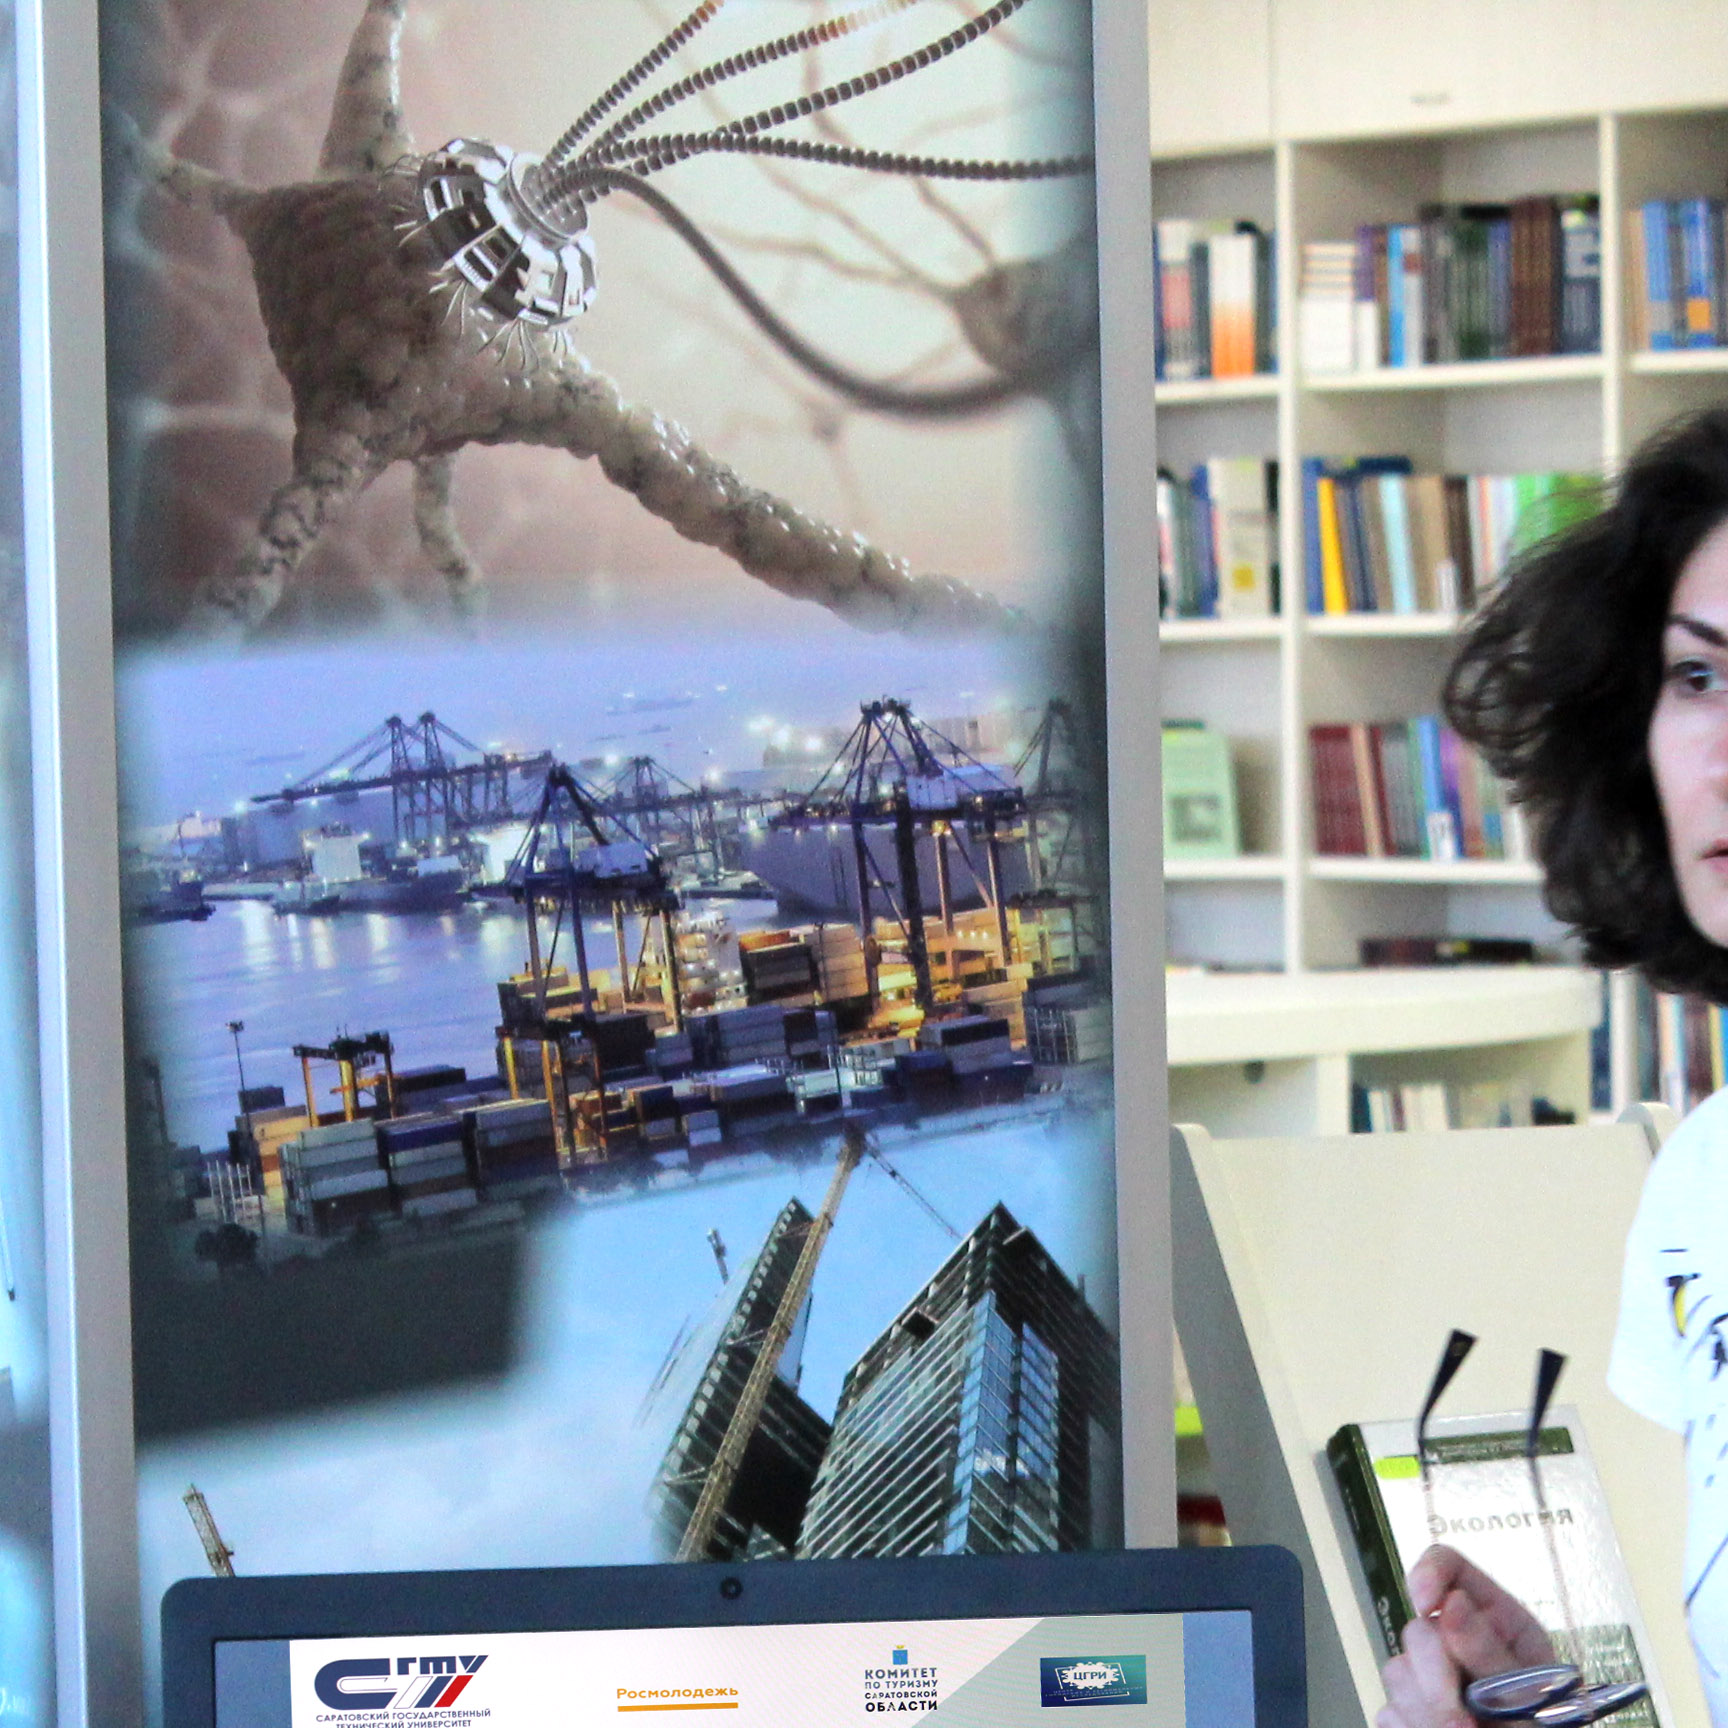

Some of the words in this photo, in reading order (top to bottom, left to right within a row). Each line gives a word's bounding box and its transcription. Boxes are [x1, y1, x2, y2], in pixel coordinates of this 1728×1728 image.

[864, 1667, 938, 1680] КОМИТЕТ
[1073, 1671, 1107, 1680] ЦГРИ
[864, 1681, 881, 1690] ПО
[885, 1679, 939, 1689] ТУРИЗМУ
[616, 1687, 739, 1699] Росмолодежь
[864, 1689, 938, 1700] САРАТОВСКОЙ
[865, 1700, 938, 1713] ОБЛАСТИ
[315, 1712, 390, 1723] САРАТОВСКИЙ
[392, 1708, 491, 1720] ГОСУДАРСТВЕННЫЙ
[407, 1719, 472, 1728] УНИВЕРСИТЕТ
